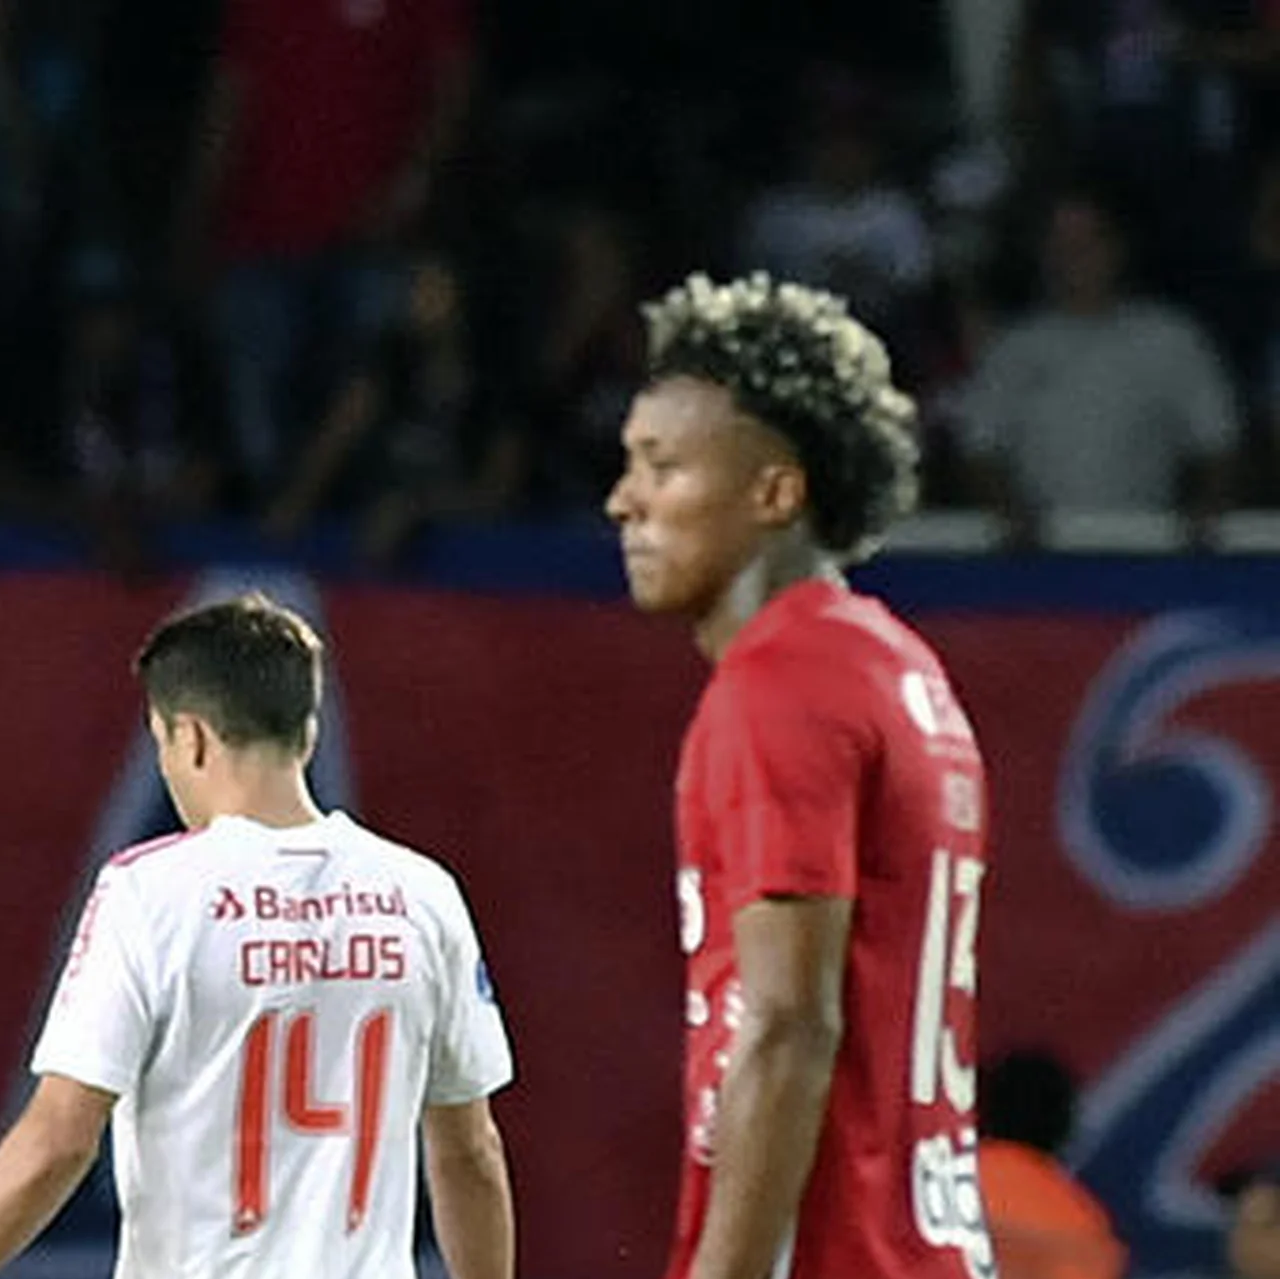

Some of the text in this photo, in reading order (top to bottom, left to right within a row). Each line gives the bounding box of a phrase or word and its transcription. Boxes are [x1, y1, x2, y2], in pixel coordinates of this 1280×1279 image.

[252, 882, 407, 922] Banrisul
[240, 933, 406, 987] CARLOS
[230, 1005, 398, 1240] 14
